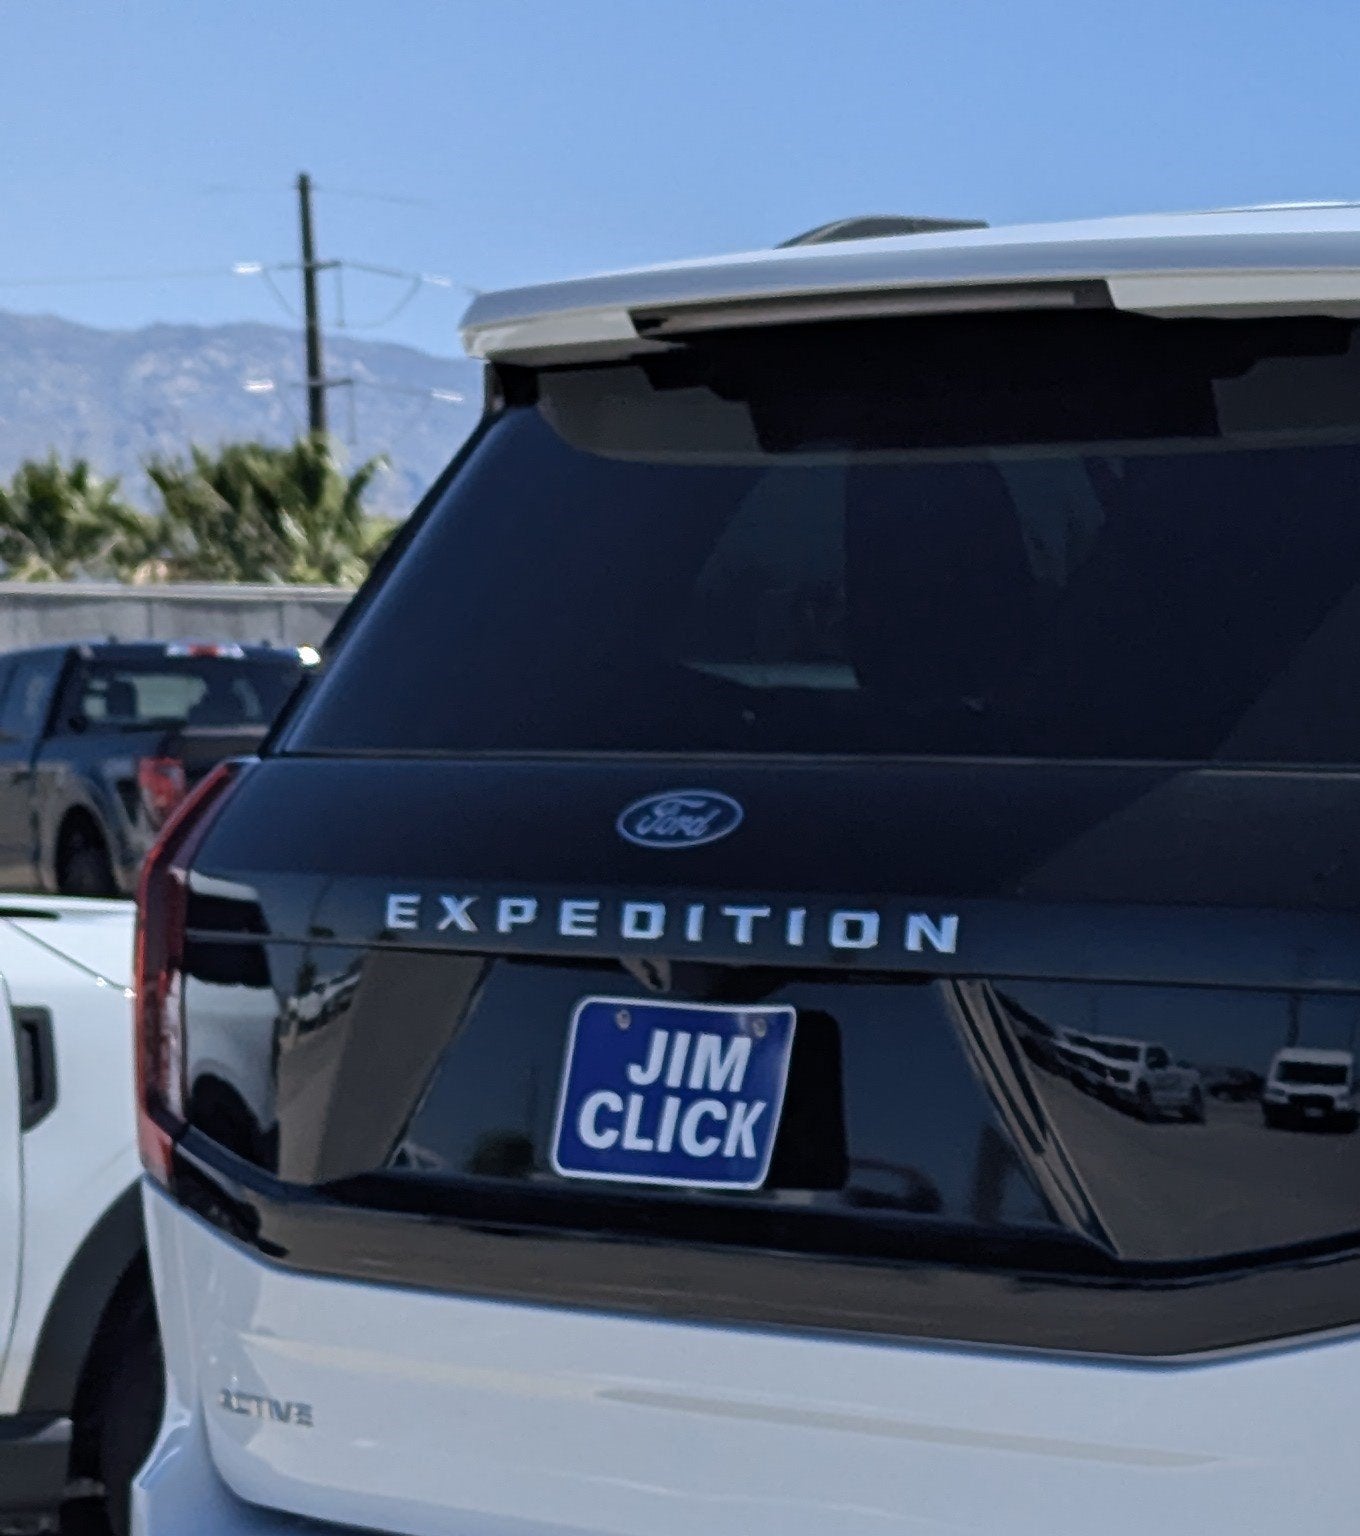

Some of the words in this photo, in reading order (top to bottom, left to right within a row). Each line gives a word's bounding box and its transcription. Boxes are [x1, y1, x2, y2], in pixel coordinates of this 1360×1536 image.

[636, 799, 721, 836] Ford
[385, 893, 959, 954] EXPEDITION
[627, 1030, 752, 1093] JIM
[577, 1091, 767, 1159] CLICK
